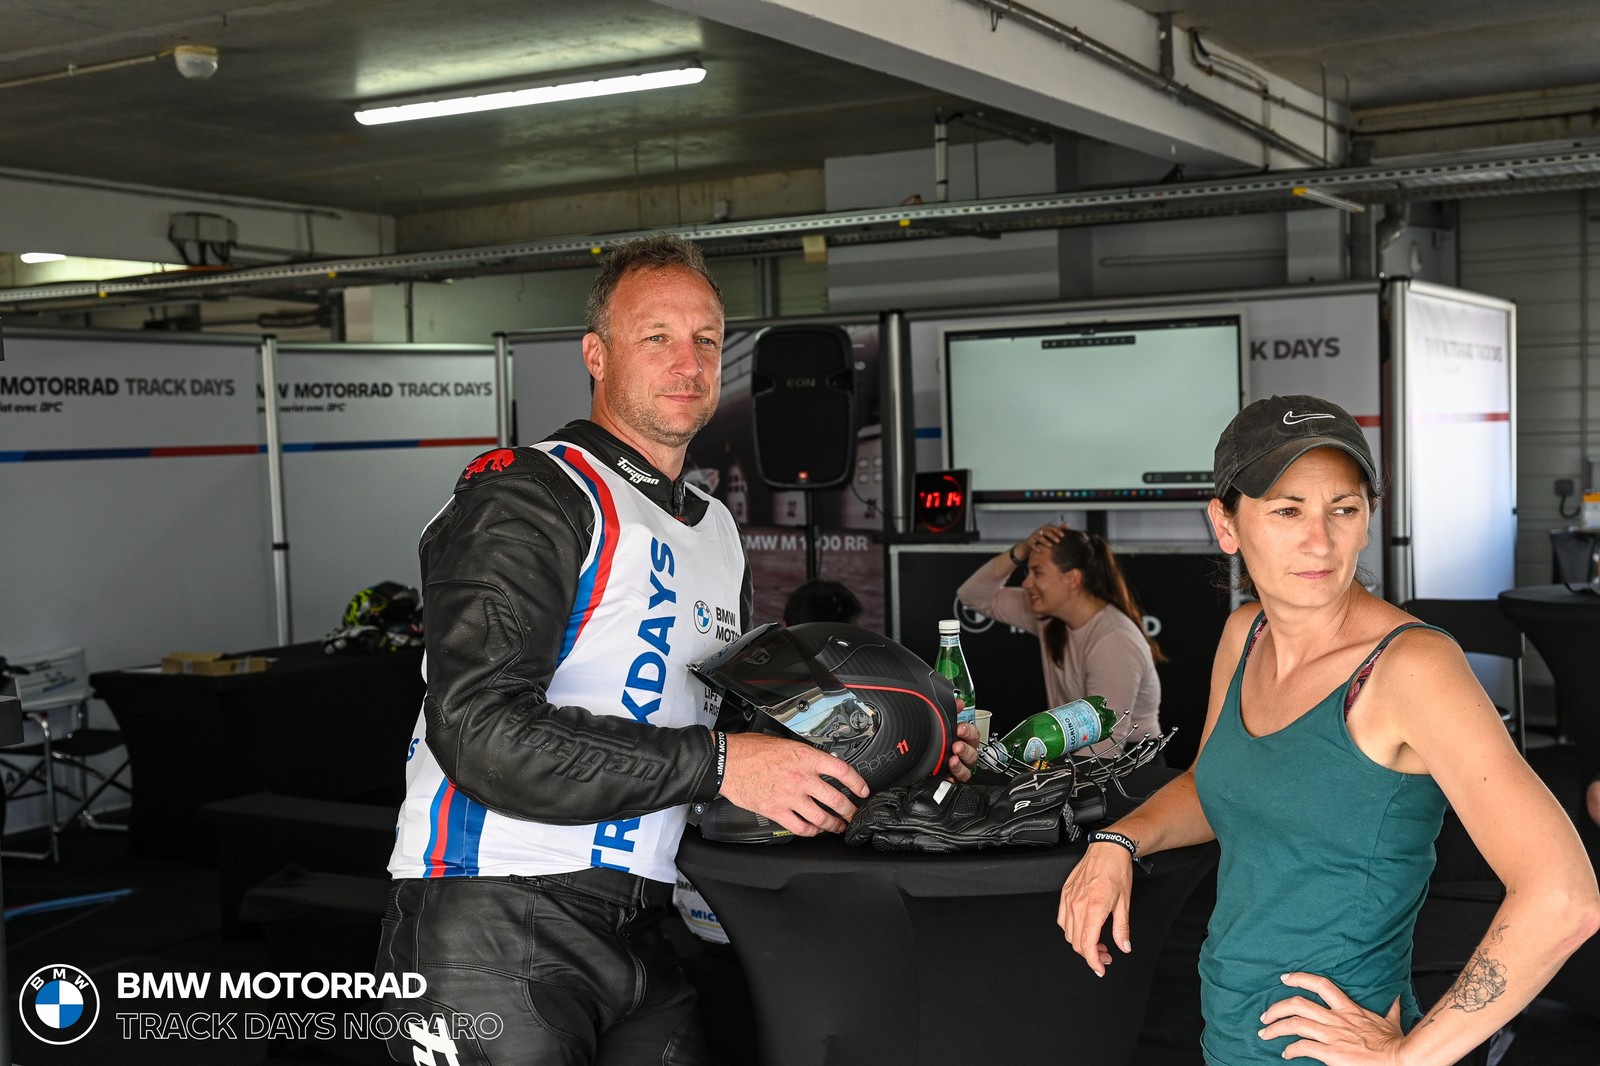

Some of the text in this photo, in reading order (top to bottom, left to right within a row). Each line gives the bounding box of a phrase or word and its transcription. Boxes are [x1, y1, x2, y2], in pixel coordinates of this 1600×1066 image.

[1273, 337, 1341, 360] DAYS
[0, 376, 236, 397] MOTORRAD TRACK DAYS
[294, 382, 393, 398] MOTORRAD
[398, 382, 450, 398] TRACK
[454, 381, 493, 397] DAYS
[743, 535, 869, 552] MW M 100 RR
[715, 606, 736, 627] BMW
[715, 624, 741, 643] MOT
[896, 738, 910, 755] 11
[716, 753, 725, 776] BMW
[1094, 832, 1135, 853] MOTORRAD
